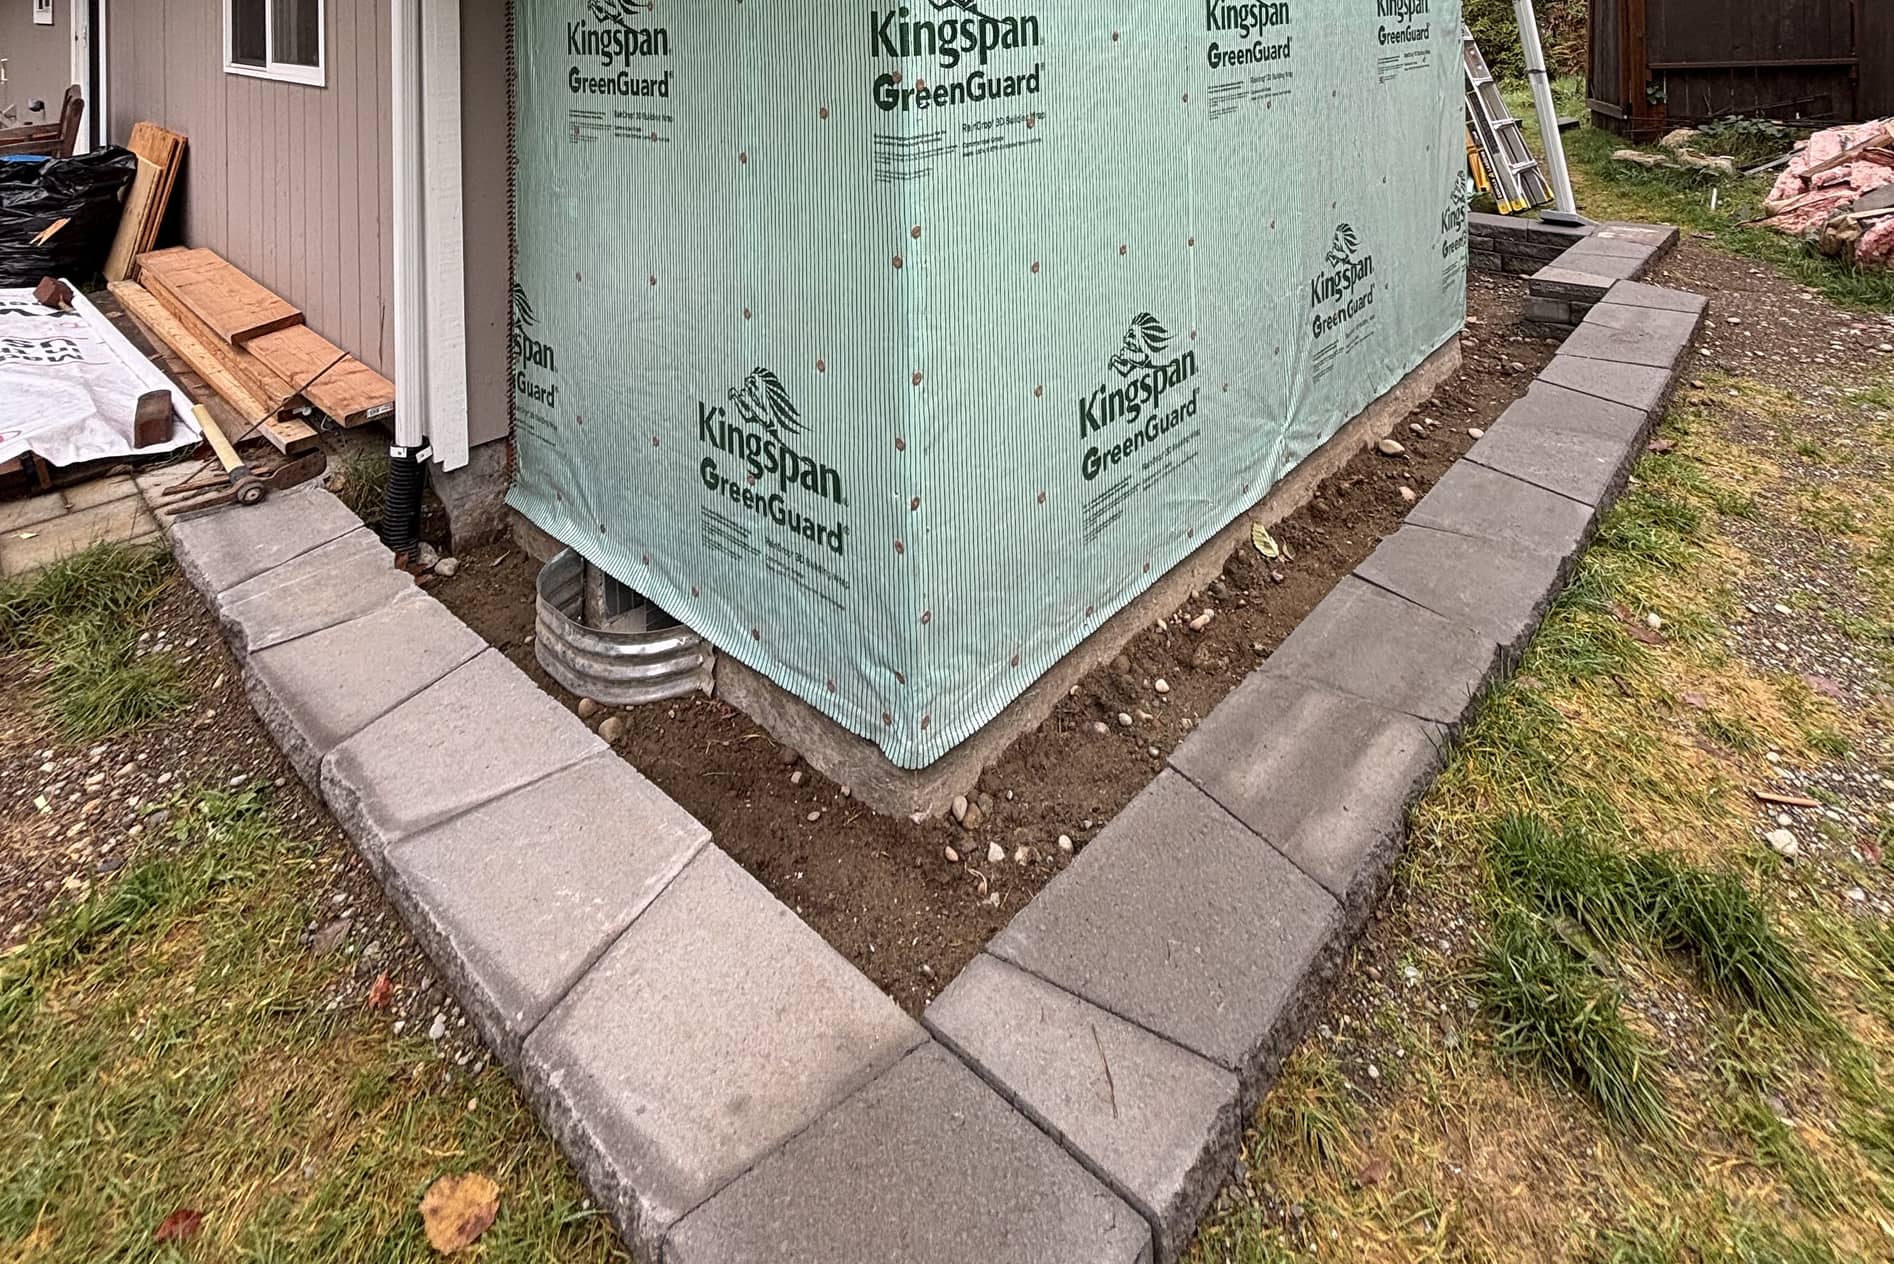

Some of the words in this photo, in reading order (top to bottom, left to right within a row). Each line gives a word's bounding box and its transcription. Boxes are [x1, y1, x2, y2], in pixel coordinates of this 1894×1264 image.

[567, 18, 668, 67] Kingspan
[870, 6, 1039, 69] Kingspan
[1207, 36, 1291, 69] GreenGuard
[1378, 24, 1430, 46] GreenGuard
[568, 65, 669, 98] GreenGuard
[873, 63, 1041, 112] GreenGuard
[1441, 204, 1467, 235] Kings
[1311, 254, 1373, 308] Kingspan
[1312, 289, 1374, 339] GreenGuard
[1079, 350, 1197, 440] Kingspan
[699, 400, 841, 505] Kingspan
[1081, 388, 1197, 481] GreenGuard
[701, 456, 843, 556] GreenGuard
